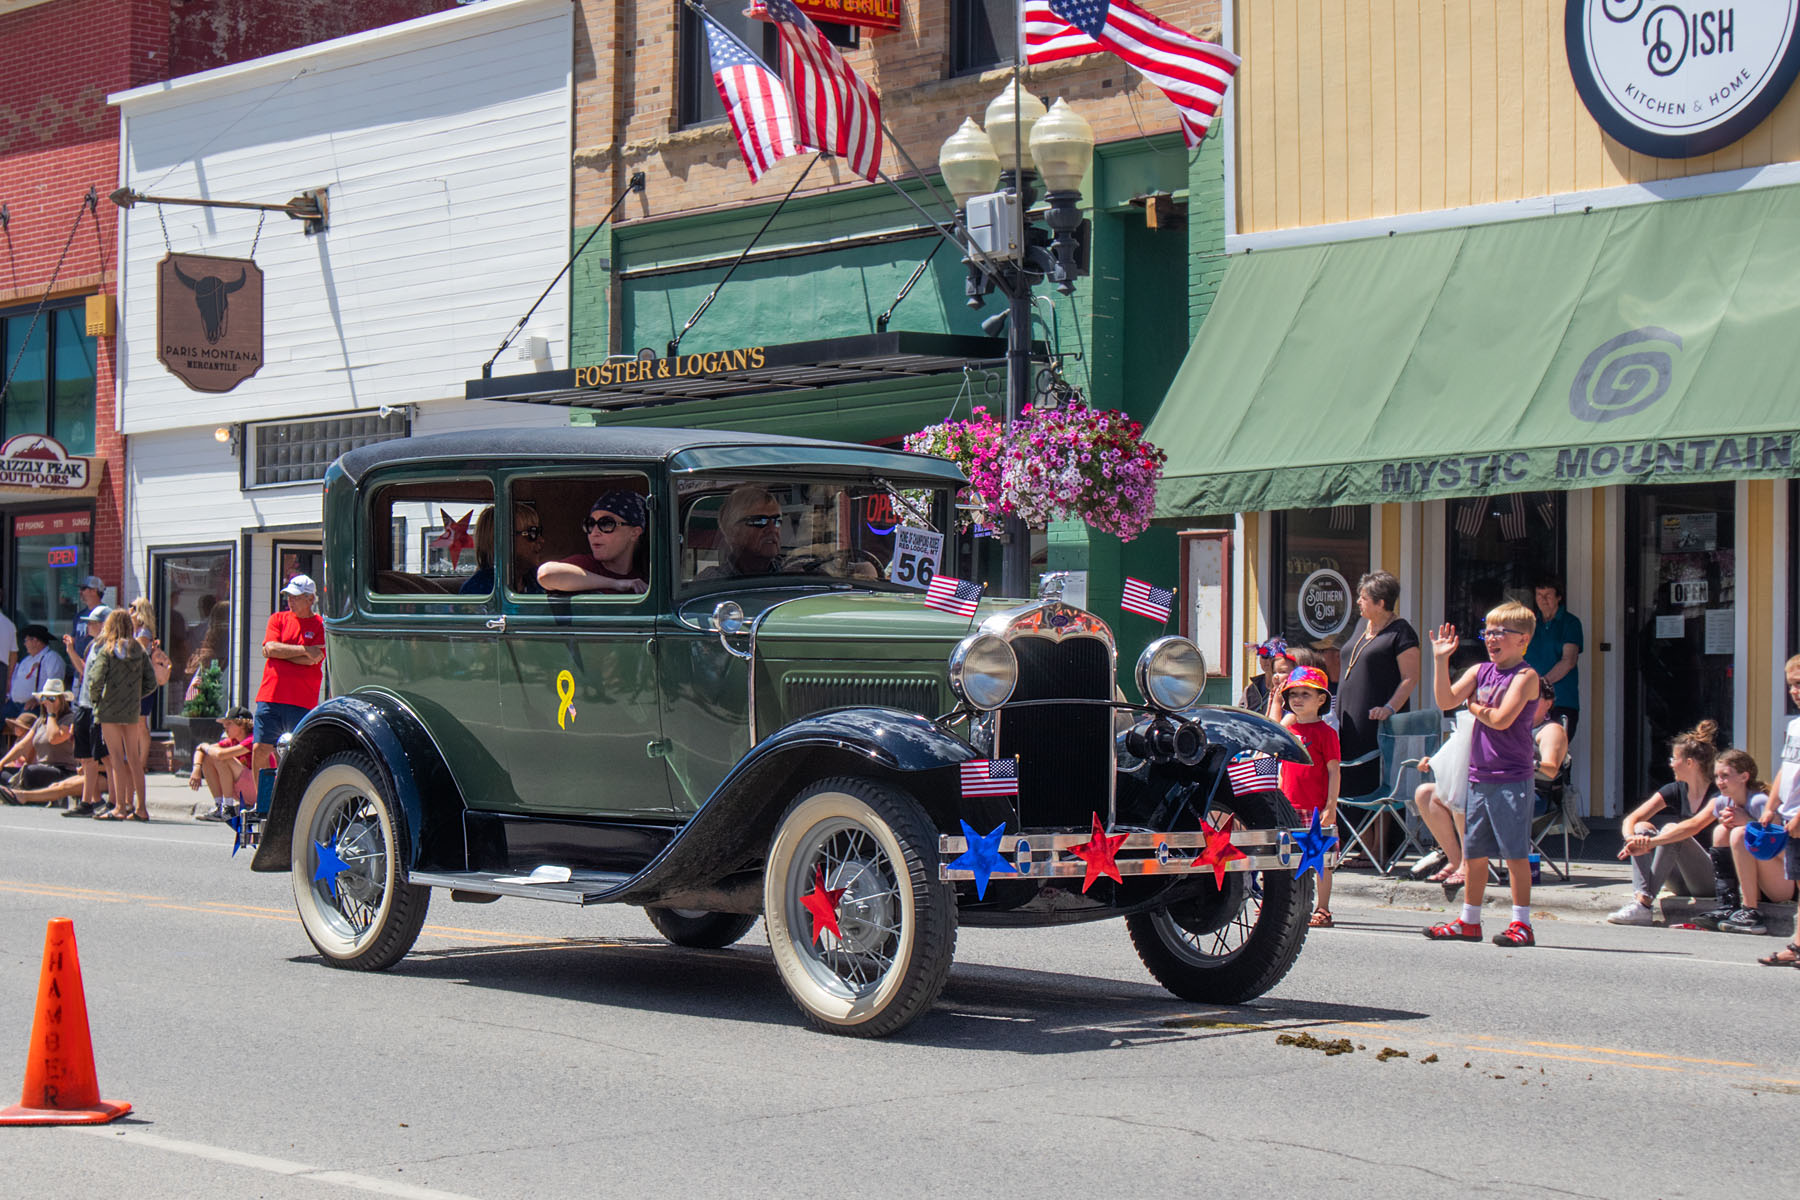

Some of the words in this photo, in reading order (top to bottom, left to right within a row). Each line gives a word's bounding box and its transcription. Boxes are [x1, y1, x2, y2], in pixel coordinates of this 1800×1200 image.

[1624, 83, 1686, 115] KITCHEN
[1693, 100, 1704, 113] &
[1709, 68, 1751, 107] HOME
[166, 345, 198, 357] PARIS
[201, 349, 258, 362] MONTANA
[187, 360, 238, 372] MERCANTILE
[574, 360, 654, 388] FOSTER
[657, 358, 671, 379] &
[675, 346, 766, 377] LOGAN'S
[47, 462, 83, 478] PEAK
[1381, 452, 1530, 494] MYSTIC
[1555, 435, 1792, 479] MOUNTAIN
[0, 471, 69, 485] OUTDOORS
[866, 493, 904, 523] OPE
[899, 542, 910, 550] RED
[48, 550, 76, 565] OPEN
[897, 552, 935, 586] 56
[1674, 581, 1708, 602] OPEN
